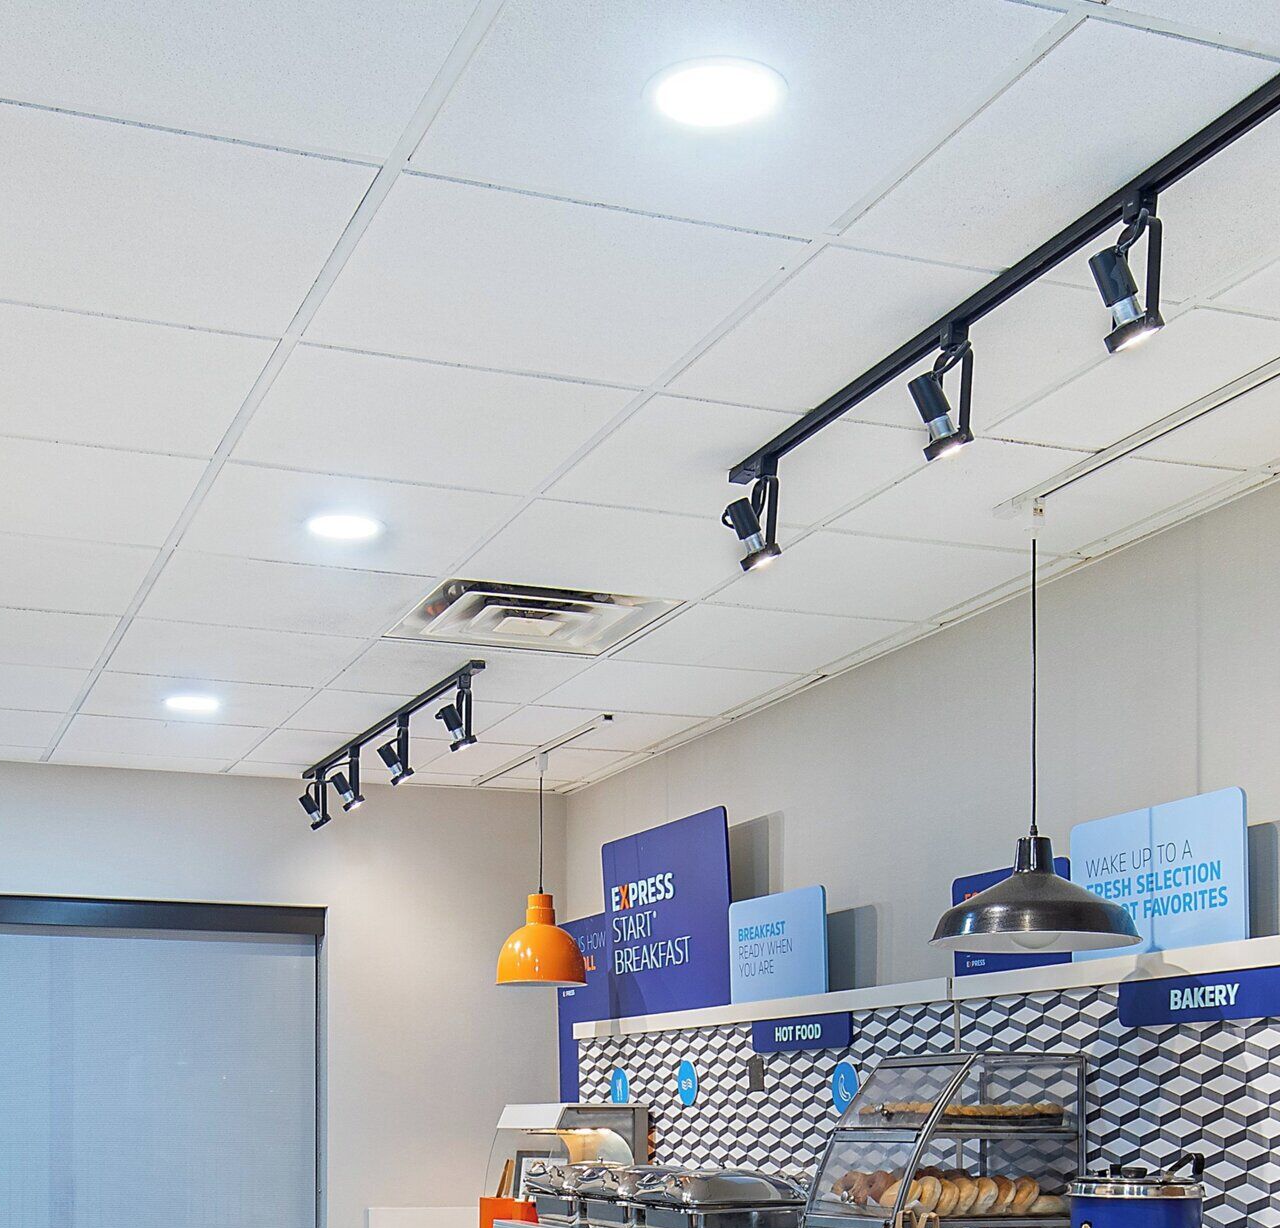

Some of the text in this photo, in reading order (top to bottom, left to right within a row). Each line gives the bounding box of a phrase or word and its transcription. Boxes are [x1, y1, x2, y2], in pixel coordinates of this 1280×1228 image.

[1085, 839, 1193, 878] WAKE UP TO A
[1136, 860, 1221, 895] SELECTION
[611, 872, 674, 912] EXPRESS
[1143, 885, 1229, 919] FAVORITES
[587, 931, 606, 950] HOW
[738, 921, 786, 942] BREAKFAST
[614, 935, 691, 975] BREAKFAST
[739, 938, 793, 960] READY WHEN
[739, 960, 774, 978] YOU ARE
[1170, 983, 1239, 1010] BAKERY
[775, 1023, 821, 1042] HOT FOOD
